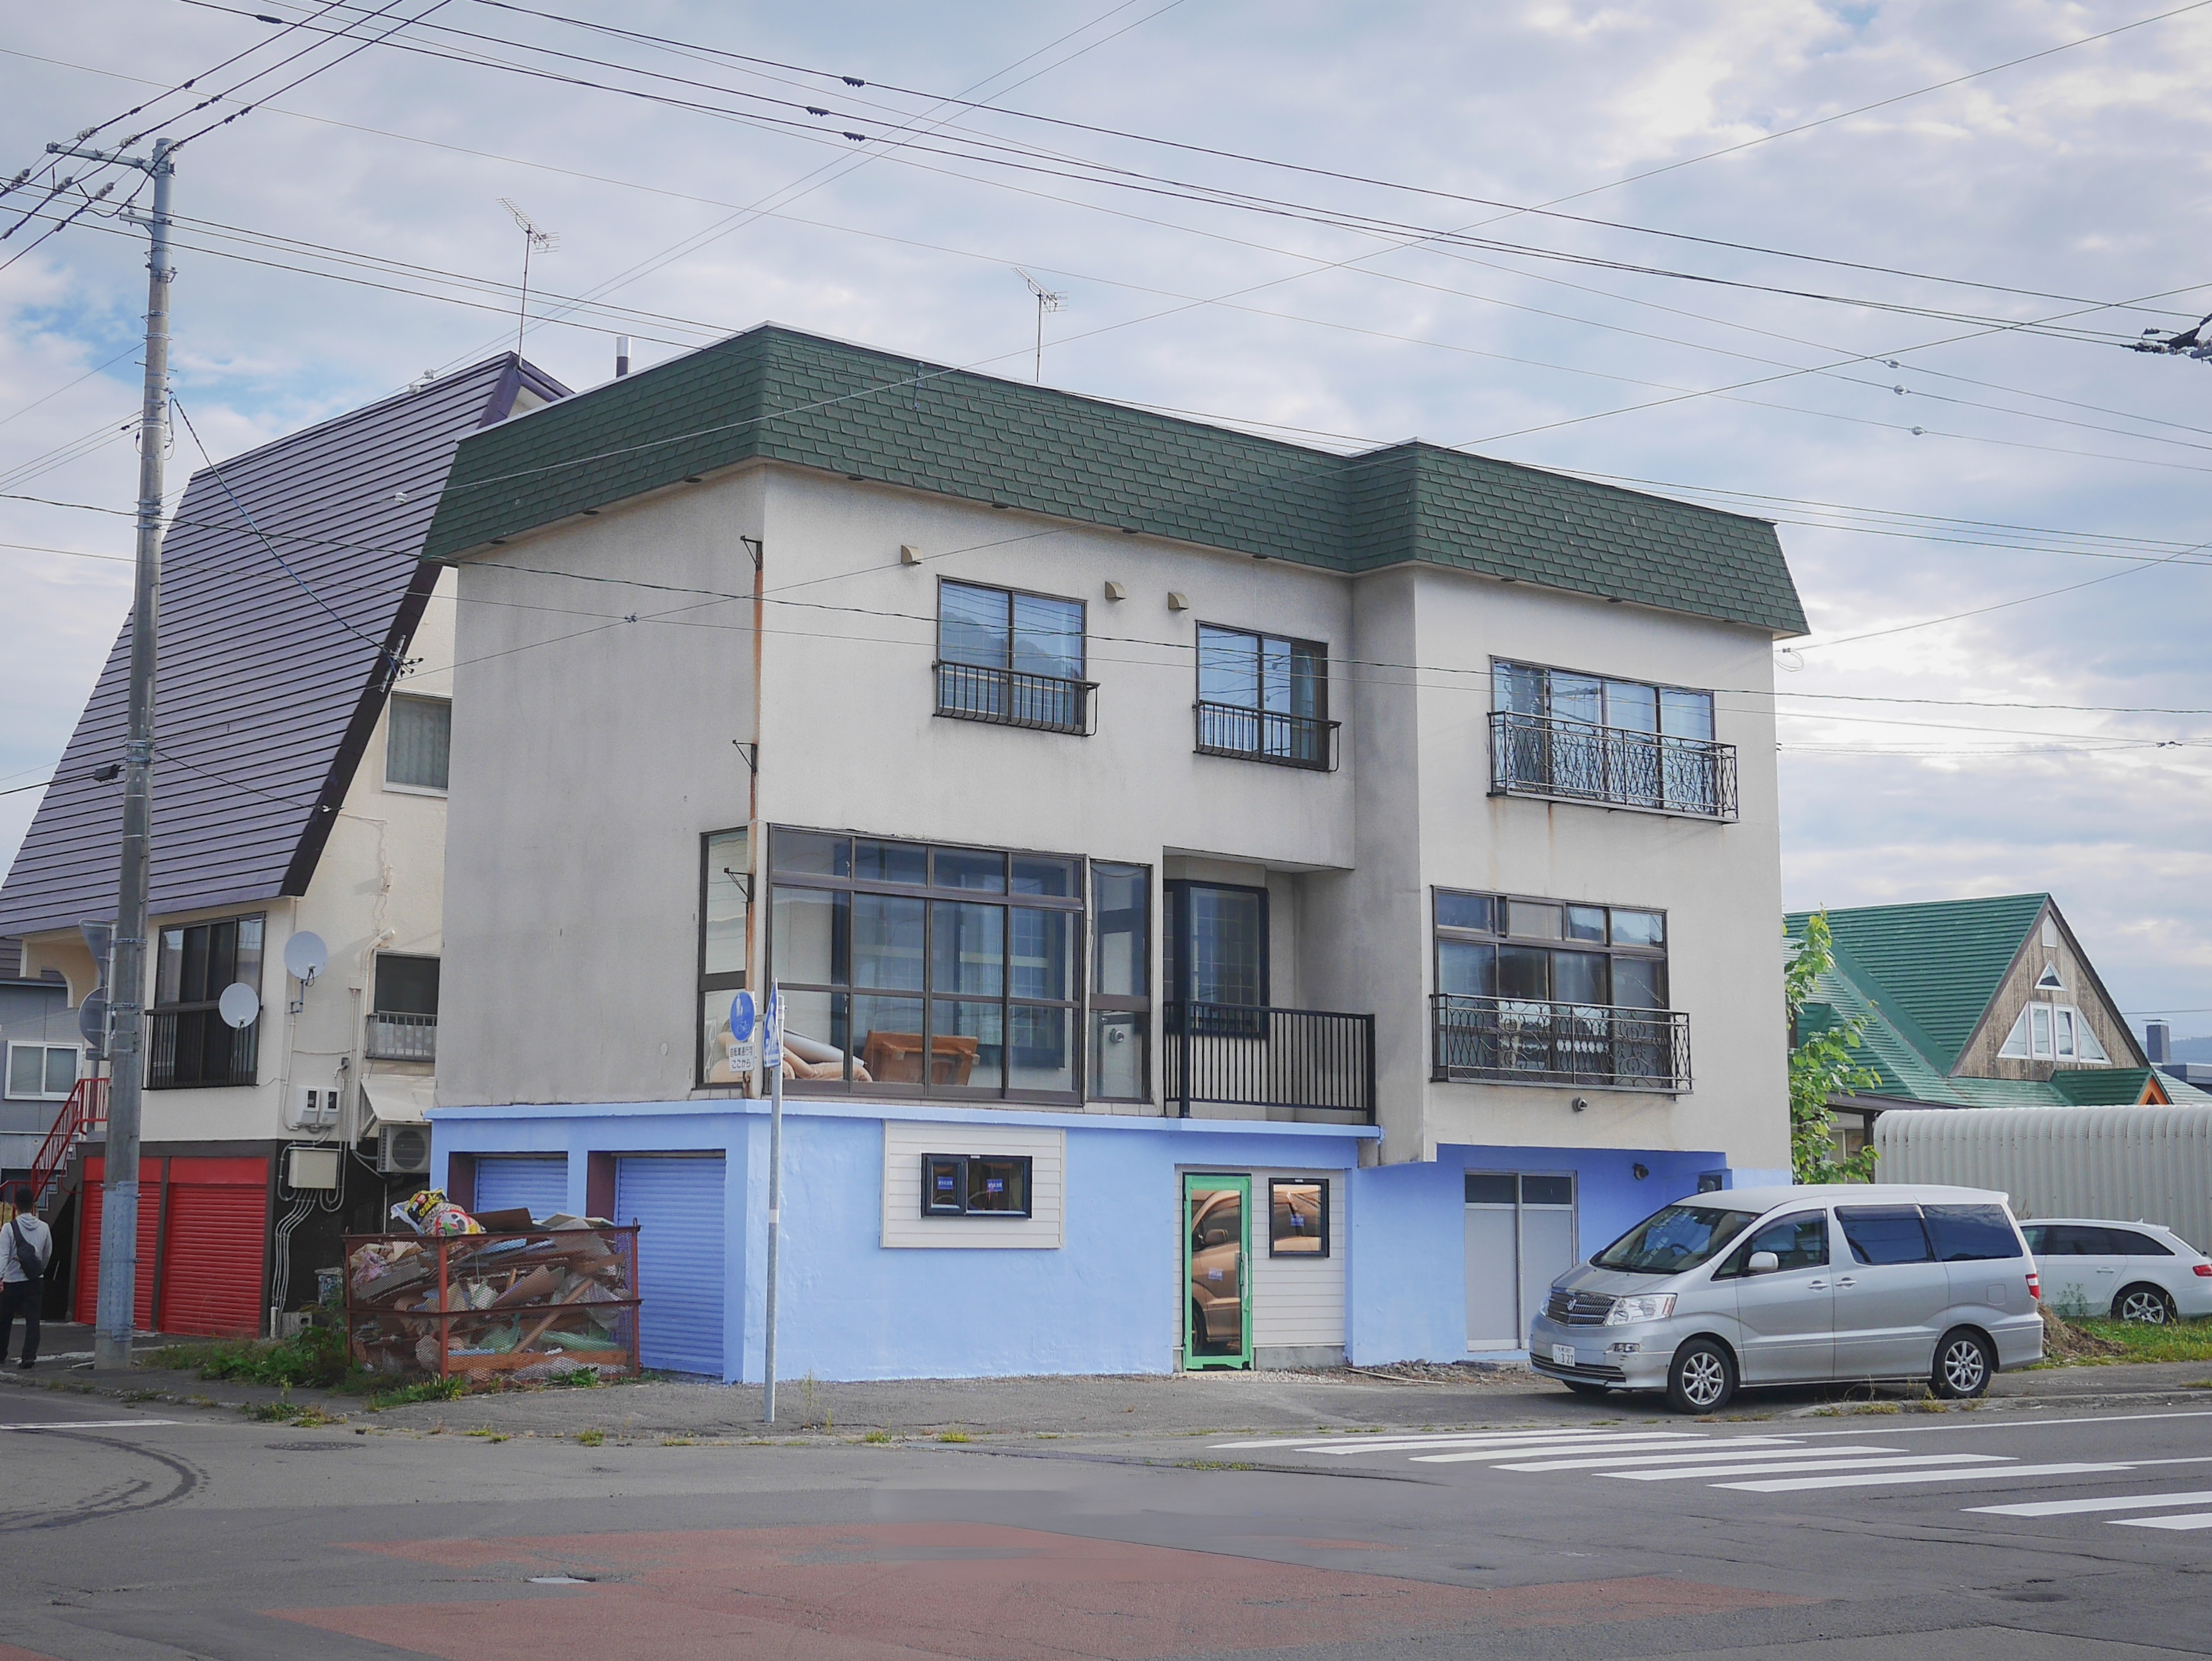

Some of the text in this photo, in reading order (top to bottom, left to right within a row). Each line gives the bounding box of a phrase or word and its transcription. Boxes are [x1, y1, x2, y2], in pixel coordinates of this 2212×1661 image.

[730, 1046, 753, 1058] 自転車通行可
[732, 1058, 751, 1069] ここから
